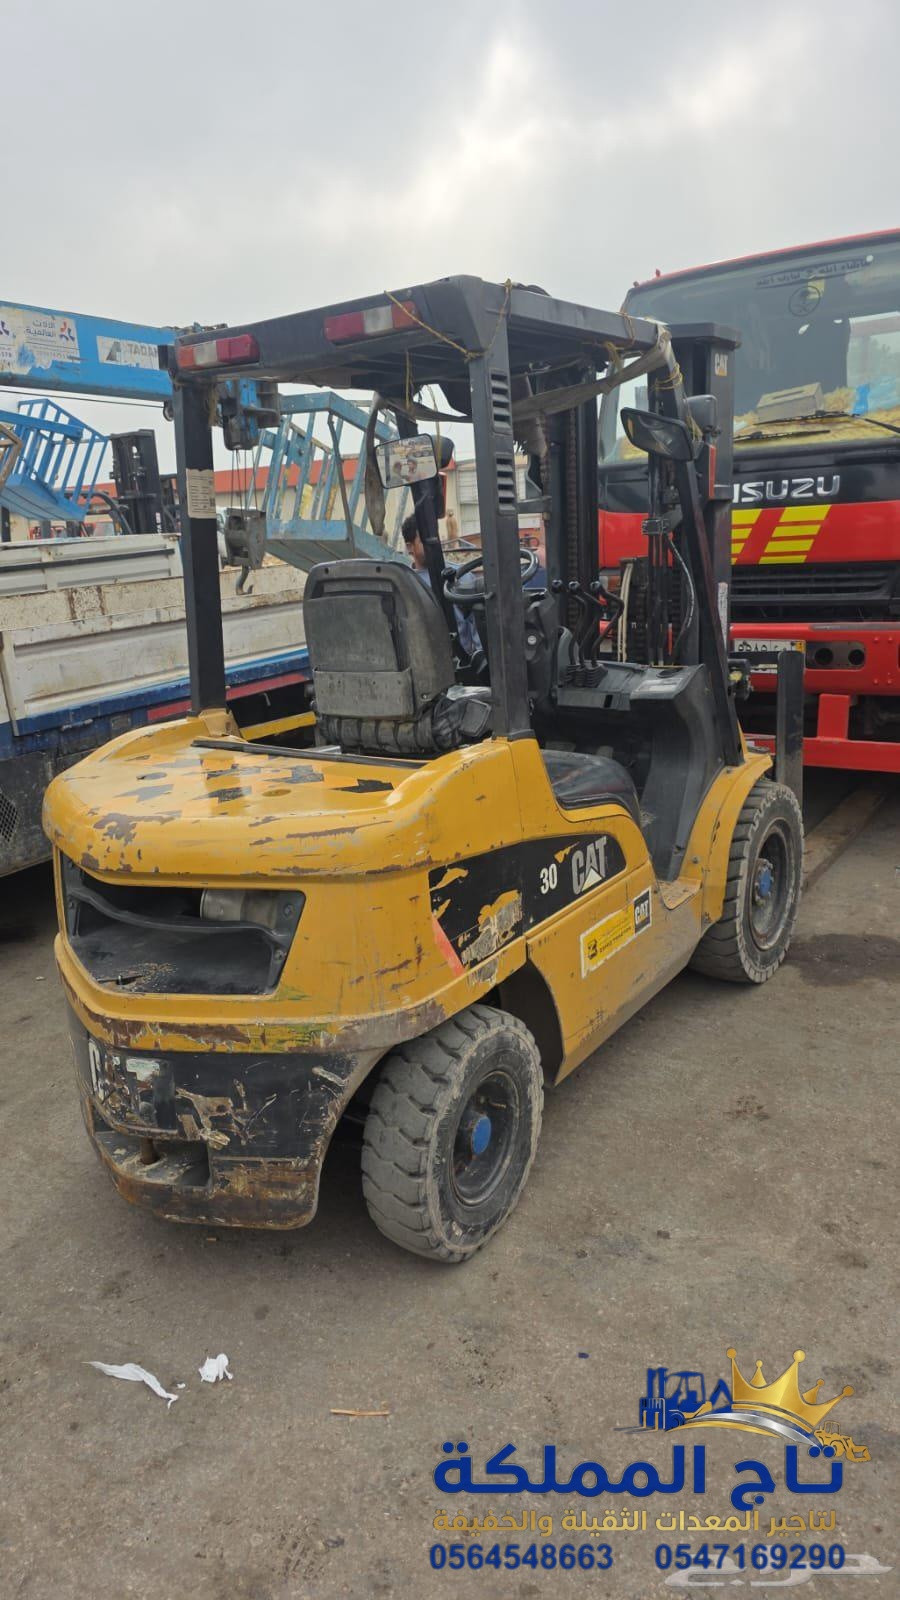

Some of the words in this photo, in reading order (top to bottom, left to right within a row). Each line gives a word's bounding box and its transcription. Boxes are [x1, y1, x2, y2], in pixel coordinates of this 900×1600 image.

[714, 352, 729, 377] CAT
[732, 475, 841, 503] ISUZU
[540, 863, 558, 895] 30
[571, 835, 607, 895] CAT
[635, 900, 650, 925] CAT
